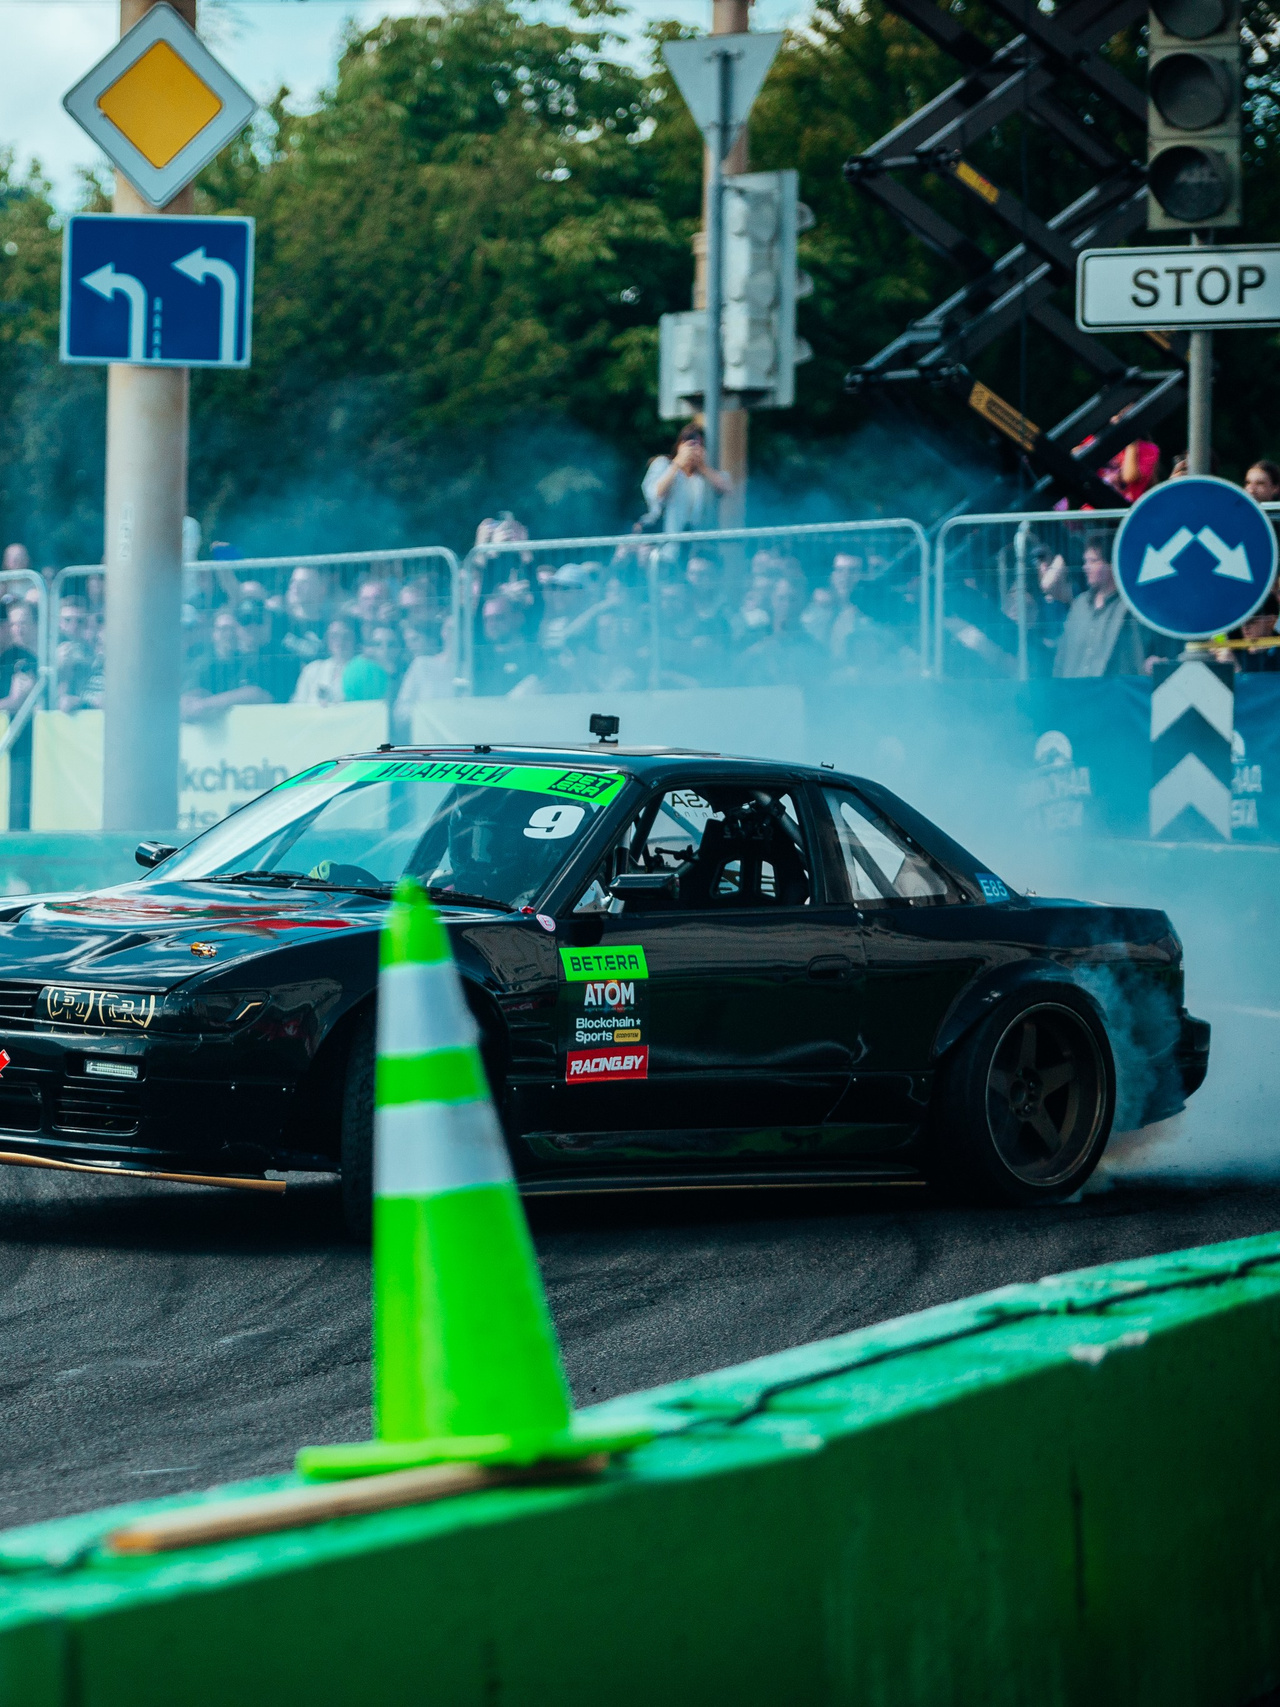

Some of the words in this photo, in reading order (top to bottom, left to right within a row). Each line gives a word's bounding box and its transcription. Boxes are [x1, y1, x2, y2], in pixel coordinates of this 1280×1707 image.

[1131, 264, 1266, 308] STOP
[564, 772, 612, 787] BET
[523, 804, 586, 840] 9
[982, 878, 1008, 897] E85
[583, 981, 635, 1006] ATOM
[575, 1016, 635, 1029] Blockchain
[575, 1030, 613, 1044] Sports
[570, 1055, 644, 1075] RACING.BY
